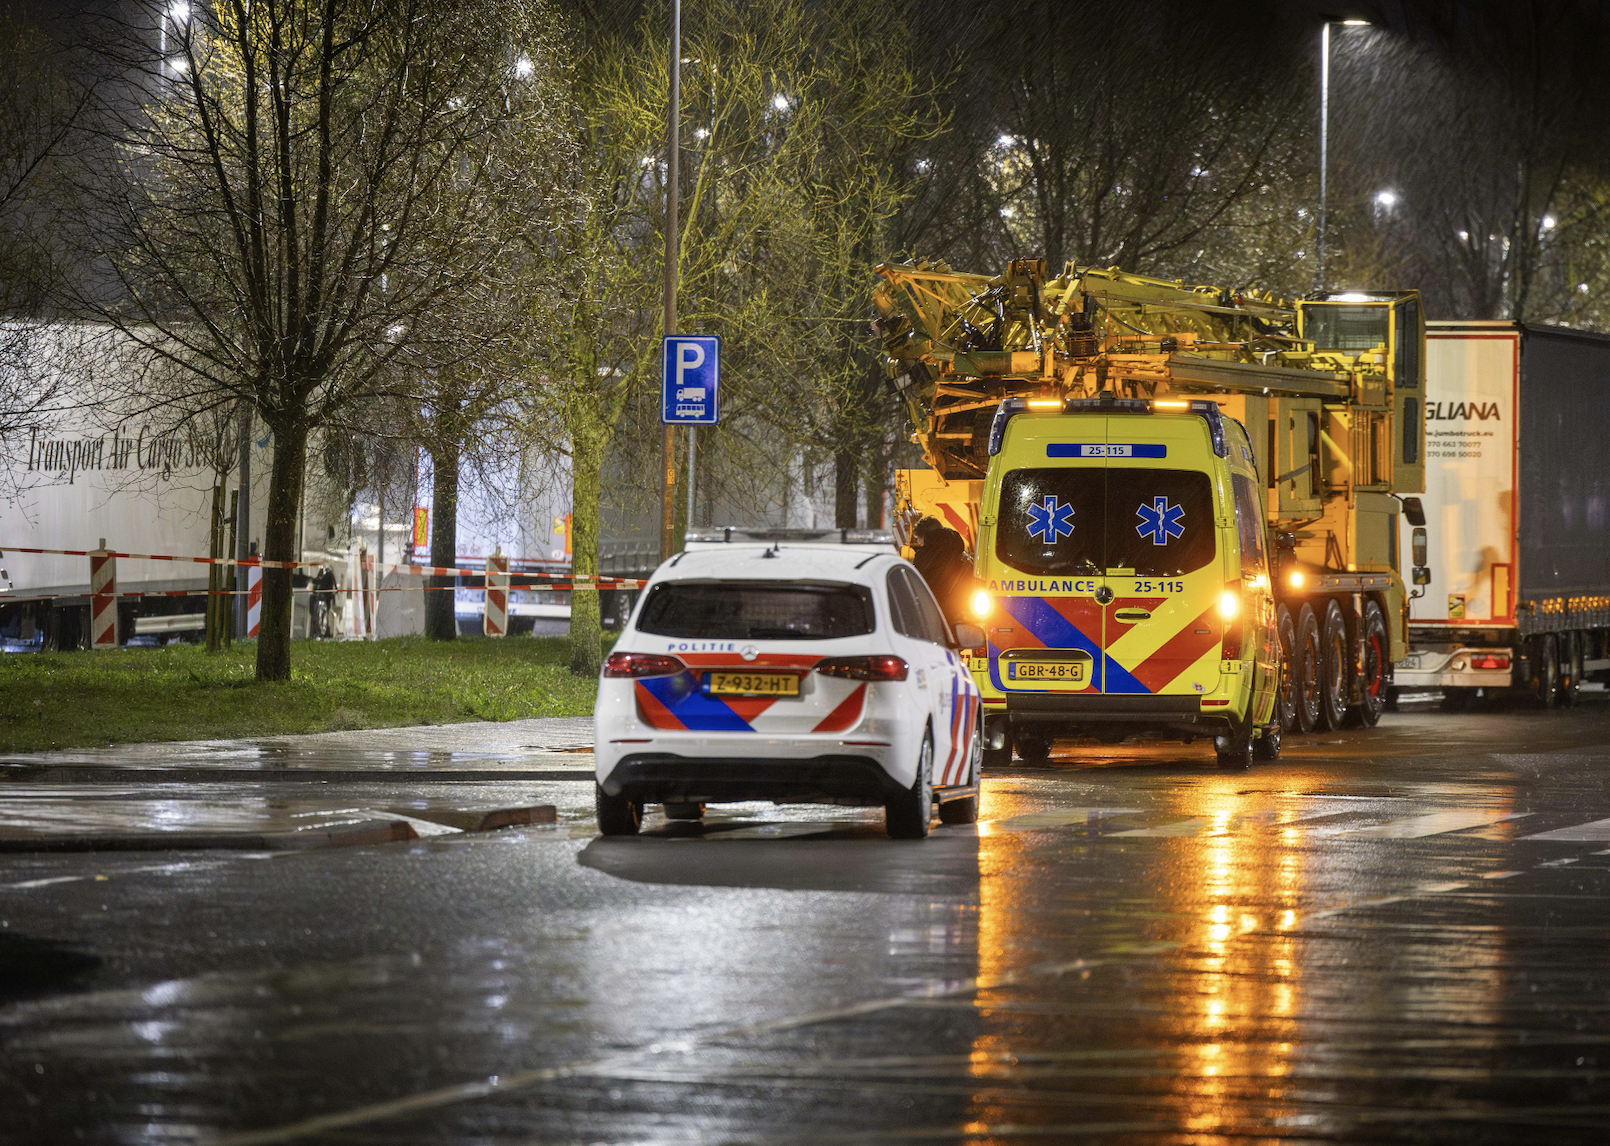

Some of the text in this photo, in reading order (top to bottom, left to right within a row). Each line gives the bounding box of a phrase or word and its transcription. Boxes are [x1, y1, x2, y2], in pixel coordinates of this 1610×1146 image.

[675, 342, 705, 385] P
[27, 426, 106, 484] Transport
[106, 425, 133, 470] Air
[137, 425, 183, 482] Cargo
[1088, 446, 1125, 455] 25-115
[989, 580, 1095, 592] AMBULANCE
[1134, 581, 1184, 592] 25-115
[668, 642, 735, 652] POLITIE
[1019, 665, 1078, 677] GBR-48-G
[716, 675, 792, 691] Z-932-HT
